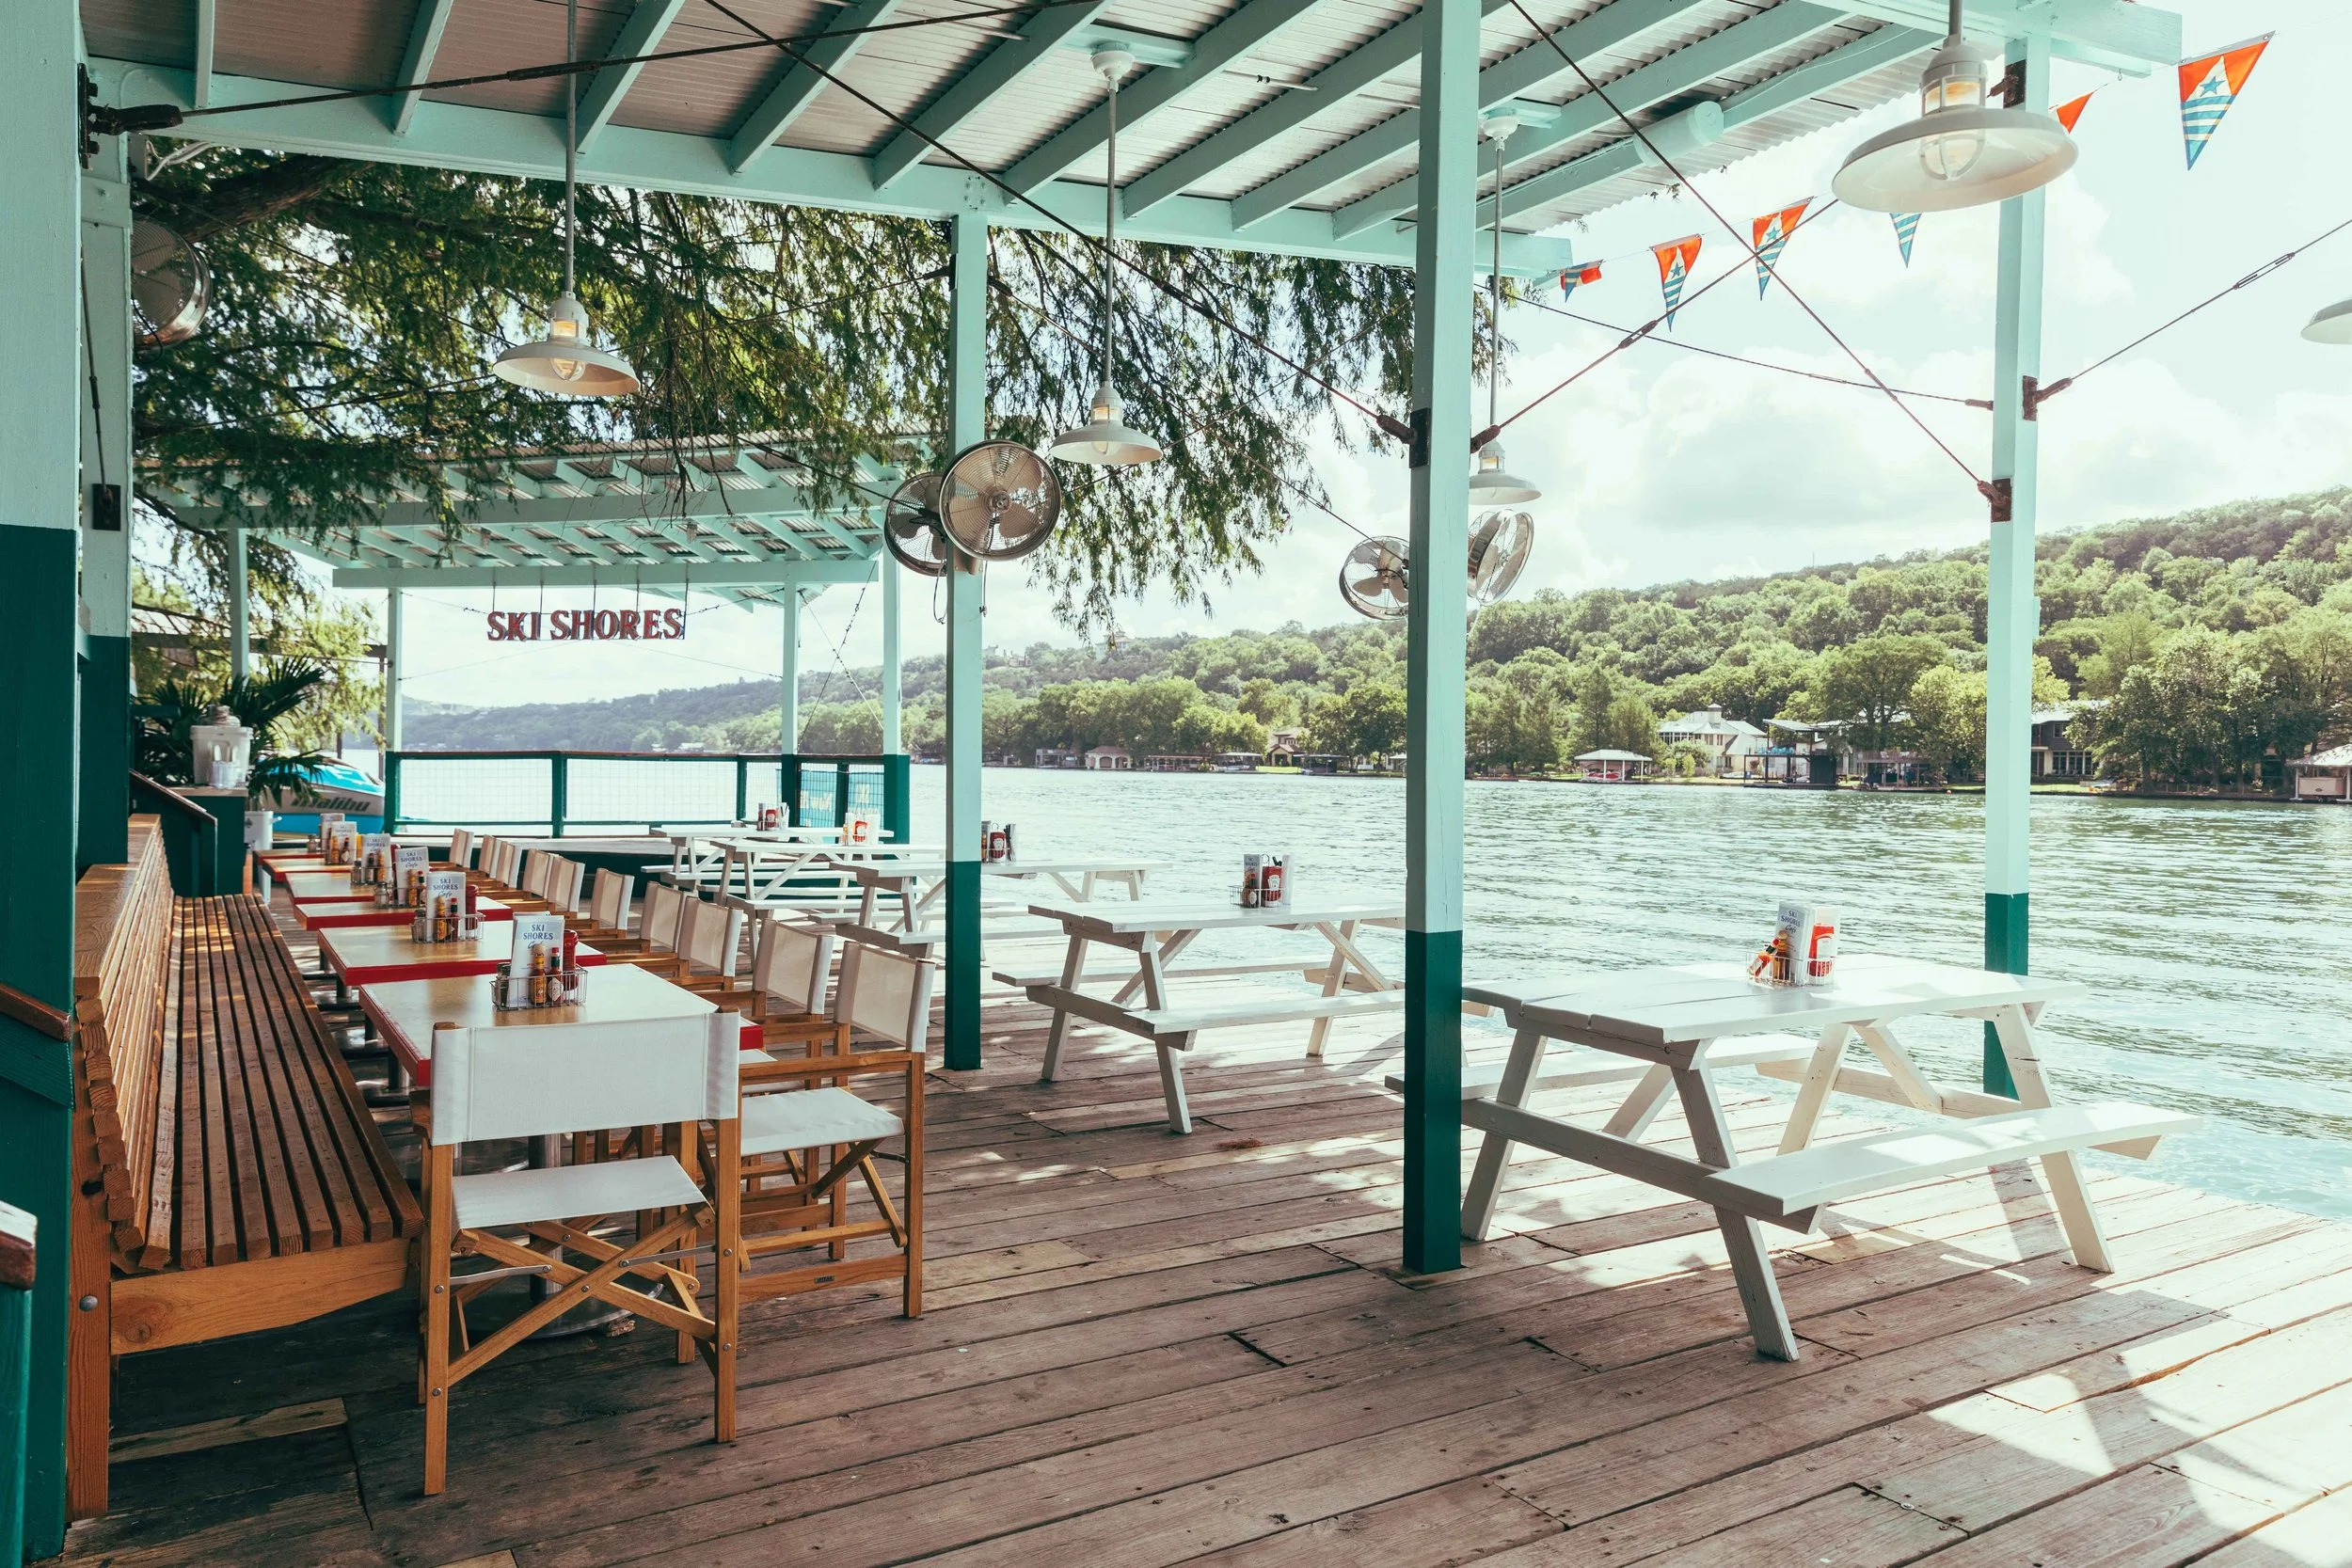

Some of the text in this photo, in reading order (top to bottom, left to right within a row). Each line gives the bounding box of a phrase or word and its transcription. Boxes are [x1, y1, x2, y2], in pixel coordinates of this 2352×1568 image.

[487, 608, 685, 641] SKI SHORES
[1788, 910, 1798, 918] SKI
[532, 924, 546, 932] SKI
[523, 932, 553, 941] SHORES
